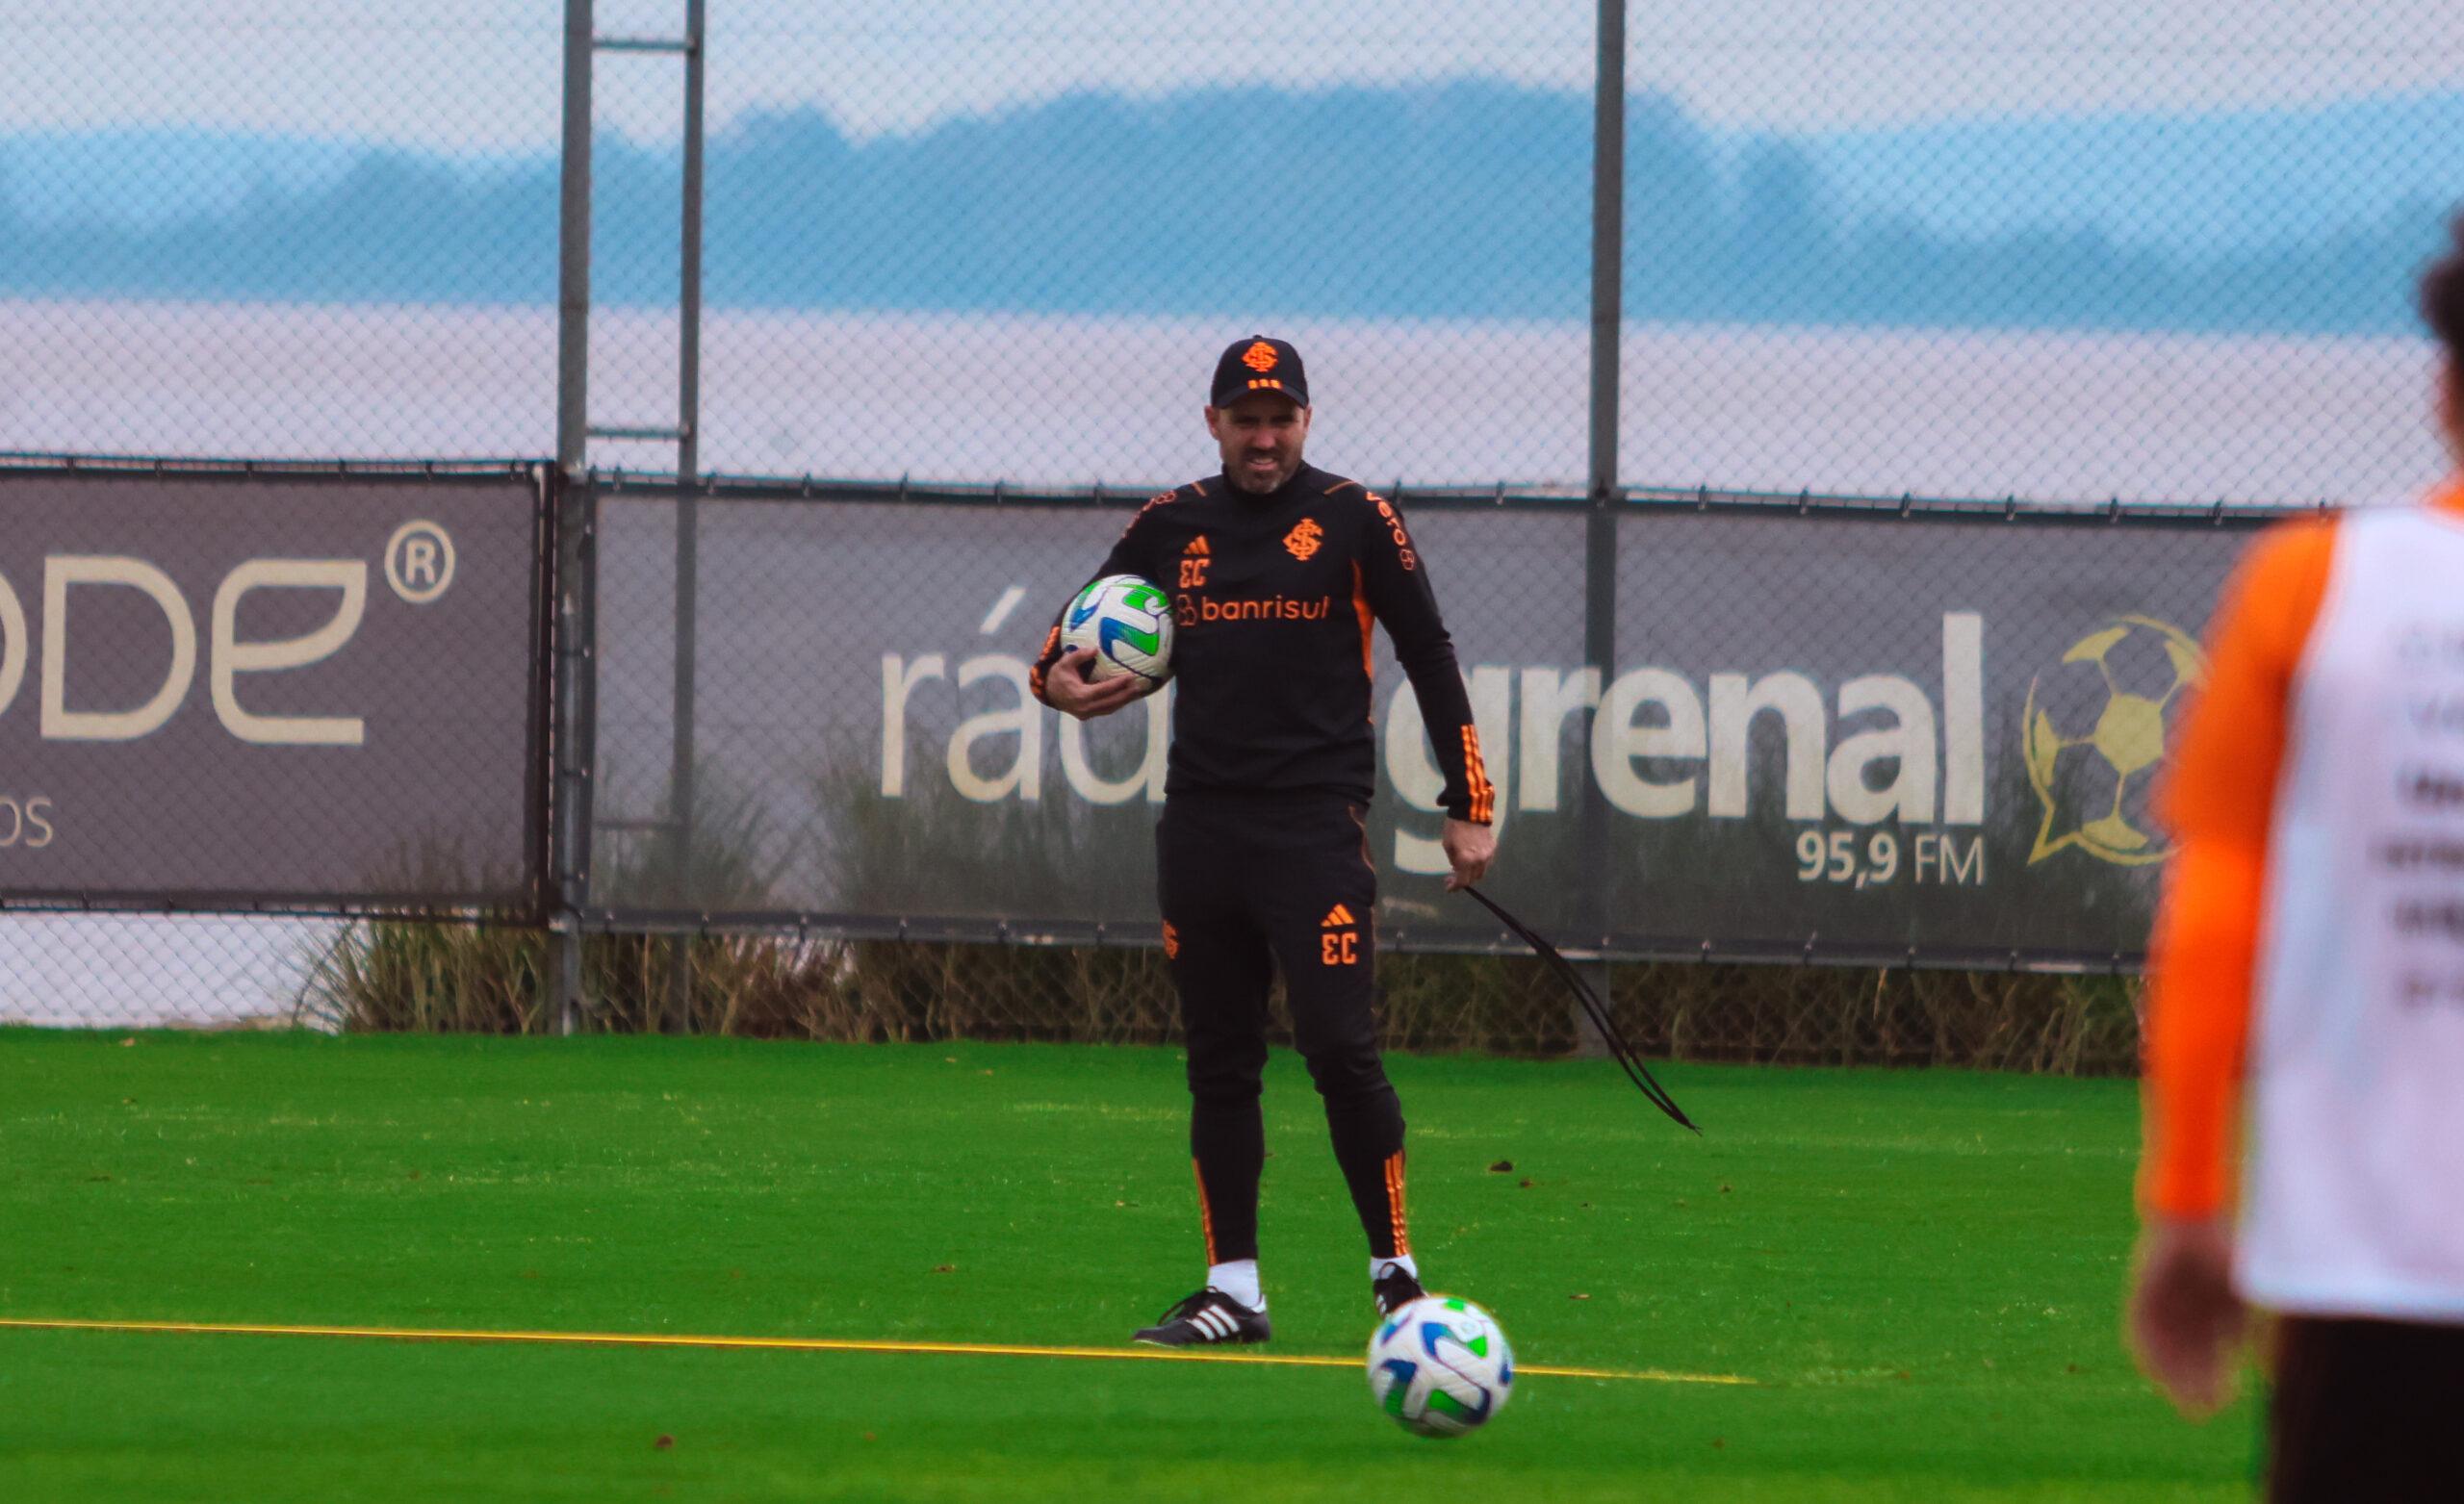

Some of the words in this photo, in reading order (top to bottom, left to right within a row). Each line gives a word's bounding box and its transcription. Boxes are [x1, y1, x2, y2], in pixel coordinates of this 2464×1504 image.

[1202, 595, 1331, 622] banrisul
[1796, 830, 1898, 889] 95,9
[1914, 832, 1984, 885] FM
